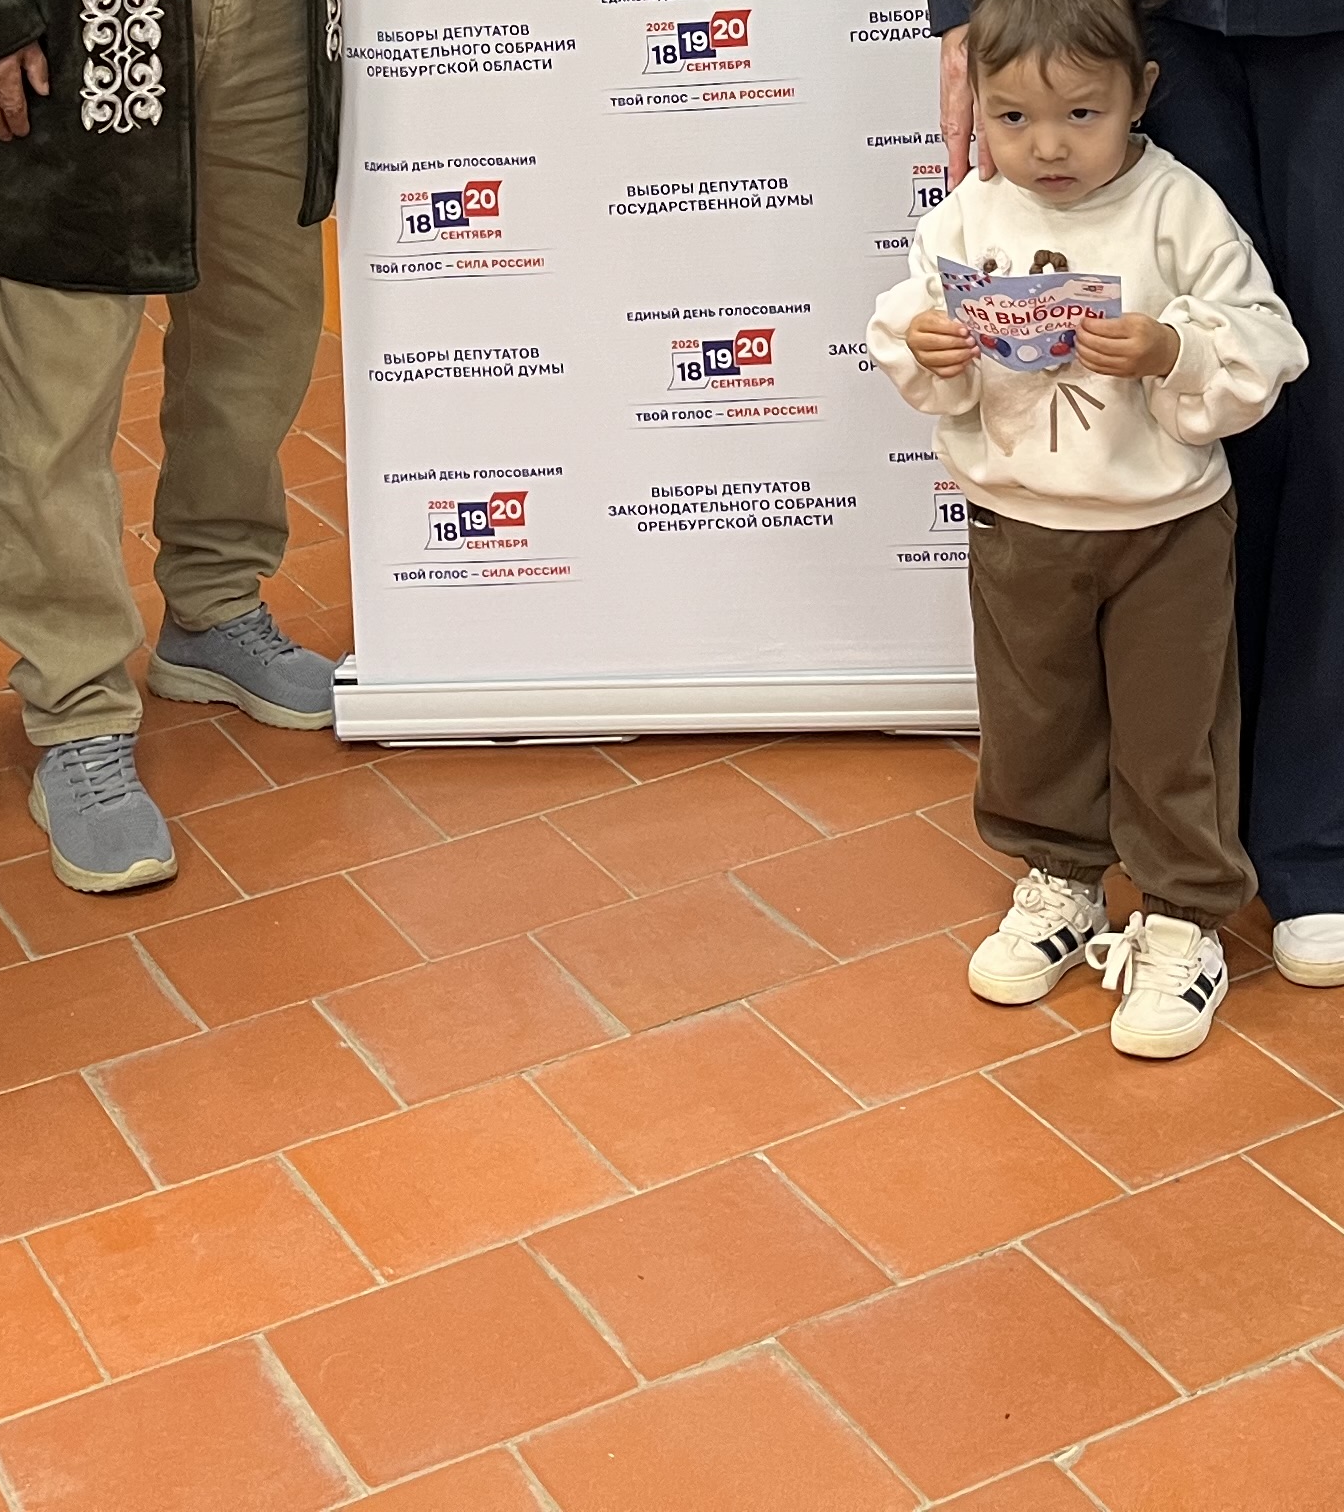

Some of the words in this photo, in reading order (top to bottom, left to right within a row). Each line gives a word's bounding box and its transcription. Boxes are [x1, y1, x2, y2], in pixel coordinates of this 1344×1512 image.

[377, 29, 439, 43] ВЫБОРЫ
[442, 24, 530, 41] ДЕПУТАТОВ
[651, 45, 677, 65] 18
[681, 30, 708, 52] 19
[712, 18, 744, 39] 20
[346, 43, 491, 62] ЗАКОНОДАТЕЛЬНОГО
[494, 38, 576, 54] СОБРАНИЯ
[366, 58, 479, 78] ОРЕНБУРГСКОЙ
[482, 58, 553, 72] ОБЛАСТИ
[685, 58, 751, 73] СЕНТЯБРЯ
[609, 93, 644, 107] ТВОЙ
[646, 93, 689, 105] ГОЛОС
[702, 90, 737, 102] СИЛА
[739, 87, 795, 100] РОССИИ!
[364, 160, 409, 172] ЕДИНЫЙ
[411, 160, 445, 173] ДЕНЬ
[447, 155, 537, 168] ГОЛОСОВАНИЯ
[626, 182, 694, 198] ВЫБОРЫ
[698, 177, 789, 196] ДЕПУТАТОВ
[406, 214, 431, 234] 18
[435, 199, 462, 221] 19
[466, 188, 495, 209] 20
[608, 193, 762, 216] ГОСУДАРСТВЕННОЙ
[765, 193, 814, 210] ДУМЫ
[440, 229, 502, 240] СЕНТЯБРЯ
[369, 262, 399, 274] ТВОЙ
[401, 261, 443, 274] ГОЛОС
[456, 259, 489, 270] СИЛА
[491, 257, 545, 268] РОССИИ!
[984, 296, 994, 307] Я
[999, 295, 1056, 309] сходил
[626, 307, 680, 322] ЕДИНЫЙ
[682, 308, 716, 320] ДЕНЬ
[718, 303, 811, 317] ГОЛОСОВАНИЯ
[985, 322, 1030, 338] своей
[383, 349, 450, 365] ВЫБОРЫ
[453, 347, 540, 362] ДЕПУТАТОВ
[677, 361, 702, 381] 18
[706, 347, 733, 369] 19
[737, 336, 768, 357] 20
[368, 365, 514, 383] ГОСУДАРСТВЕННОЙ
[517, 362, 565, 378] ДУМЫ
[710, 376, 775, 389] СЕНТЯБРЯ
[635, 409, 669, 422] ТВОЙ
[671, 409, 713, 421] ГОЛОС
[726, 407, 761, 418] СИЛА
[763, 405, 818, 416] РОССИИ!
[383, 468, 437, 484] ЕДИНЫЙ
[439, 470, 471, 482] ДЕНЬ
[473, 466, 563, 479] ГОЛОСОВАНИЯ
[651, 484, 718, 498] ВЫБОРЫ
[721, 481, 811, 497] ДЕПУТАТОВ
[607, 499, 770, 517] ЗАКОНОДАТЕЛЬНОГО
[774, 496, 857, 510] СОБРАНИЯ
[434, 522, 457, 542] 18
[461, 509, 487, 530] 19
[492, 499, 522, 520] 20
[637, 513, 758, 532] ОРЕНБУРГСКОЙ
[761, 514, 834, 528] ОБЛАСТИ
[466, 538, 528, 550] СЕНТЯБРЯ
[392, 568, 426, 582] ТВОЙ
[428, 569, 468, 580] ГОЛОС
[481, 568, 515, 578] СИЛА
[517, 565, 571, 577] РОССИИ!
